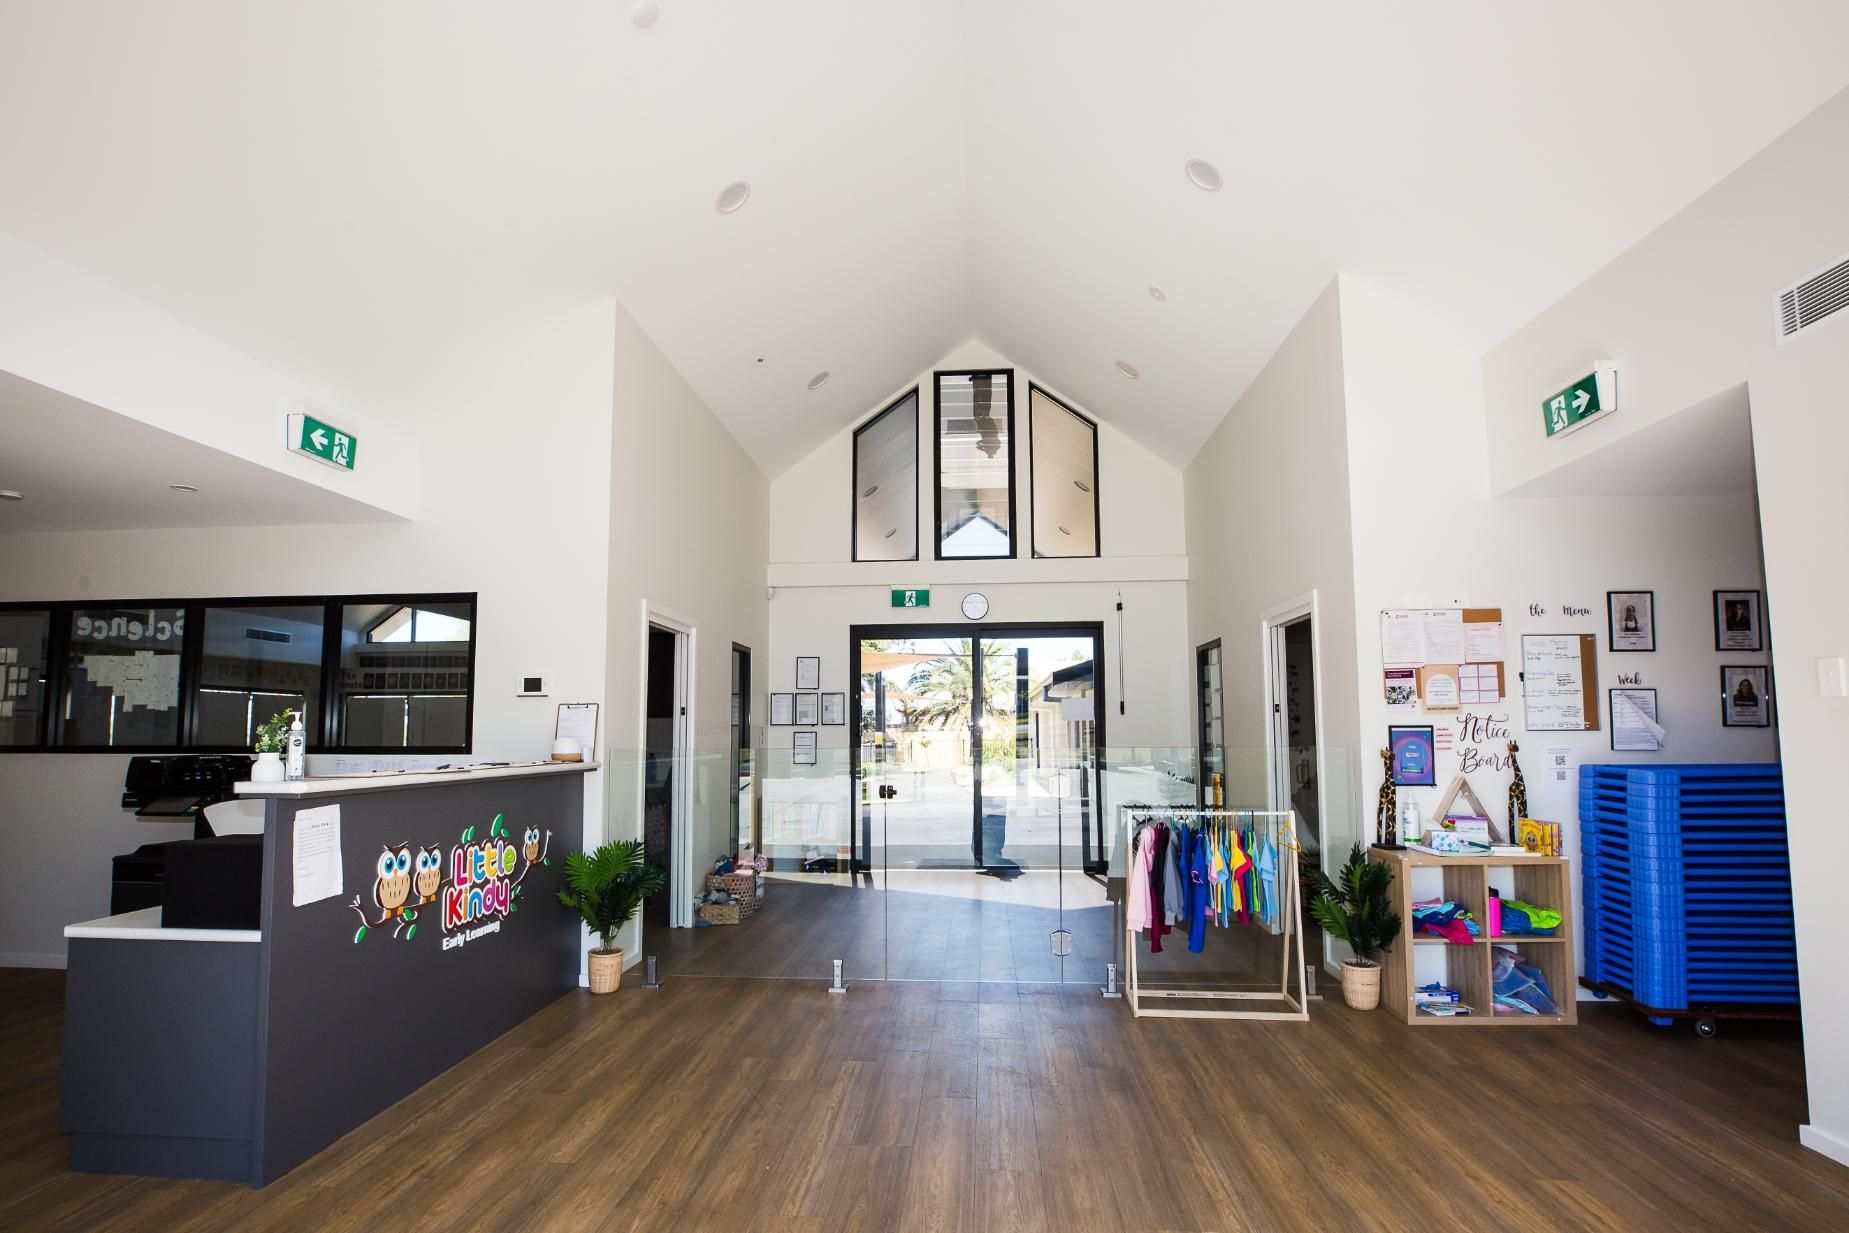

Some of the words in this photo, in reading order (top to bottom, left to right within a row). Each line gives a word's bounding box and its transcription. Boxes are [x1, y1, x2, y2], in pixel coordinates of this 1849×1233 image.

[1529, 603, 1547, 617] the
[1562, 605, 1592, 617] Menu
[1617, 671, 1642, 686] Week
[1456, 712, 1511, 744] Notice
[1457, 747, 1512, 774] Board
[454, 839, 517, 888] Little
[446, 878, 510, 928] Kindy
[442, 932, 465, 951] Early
[465, 920, 501, 942] Learning
